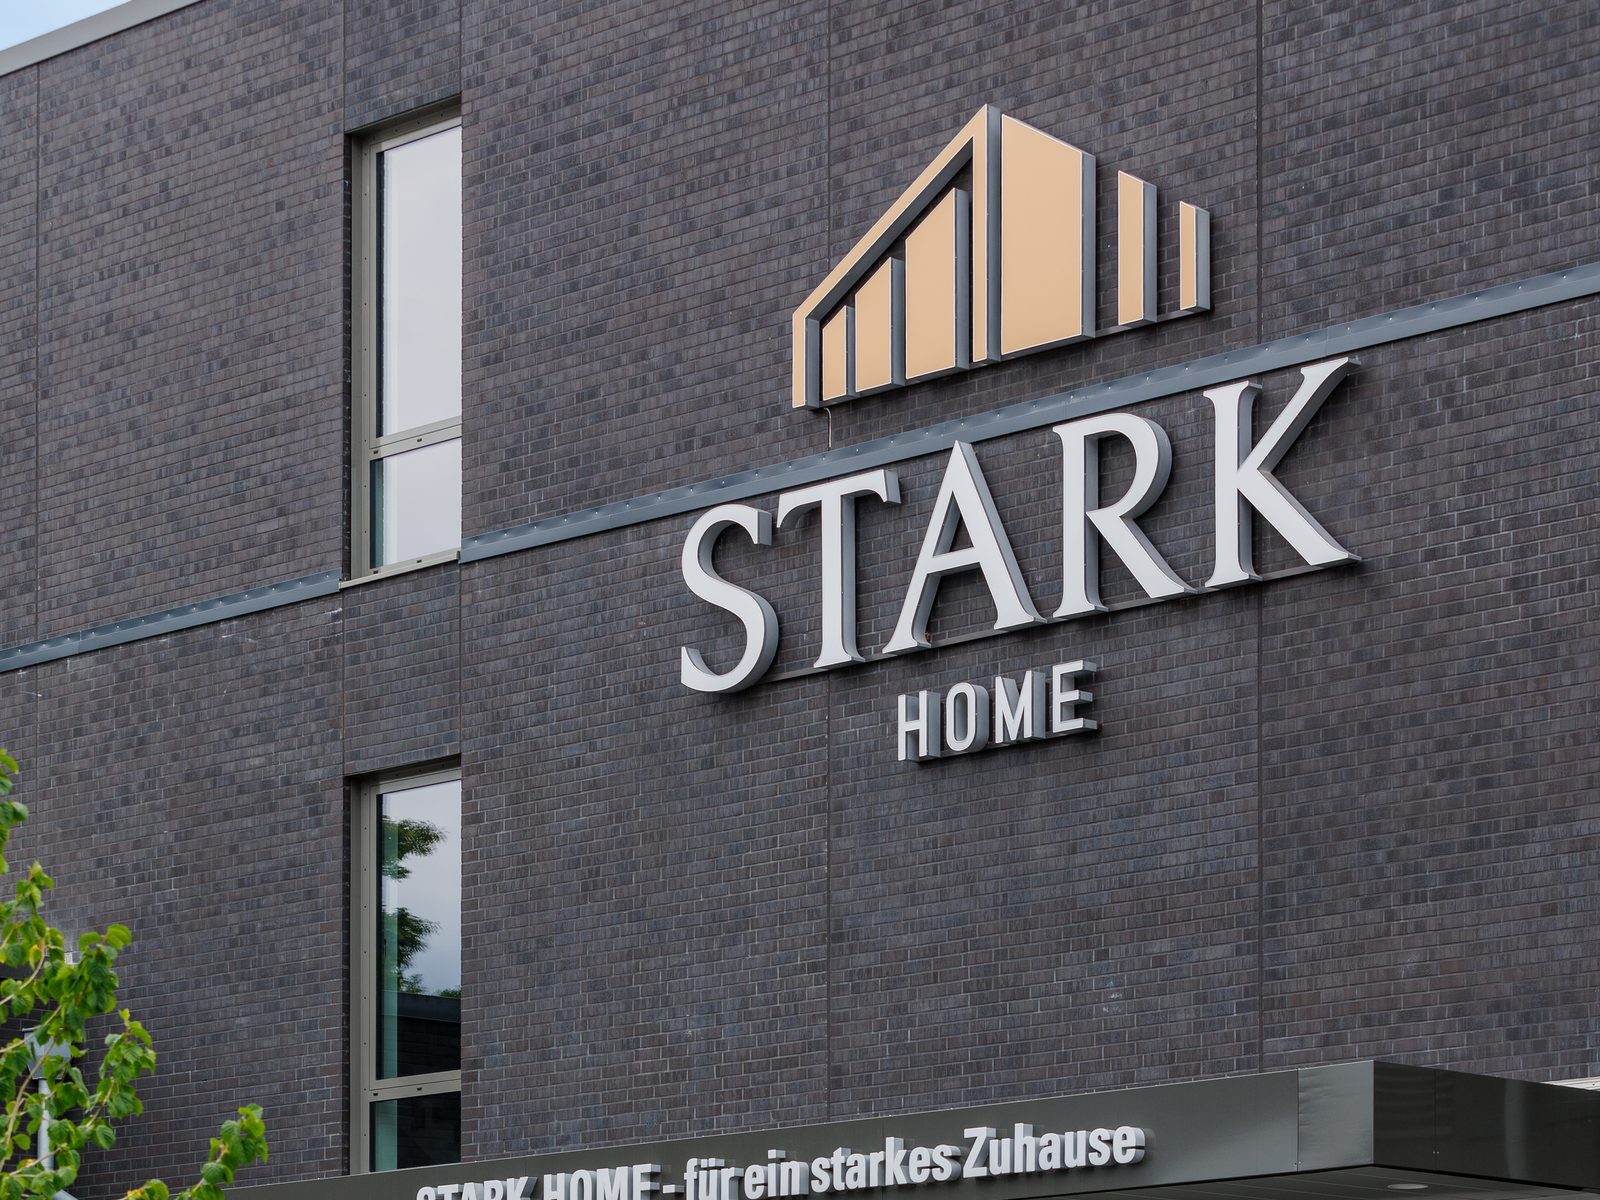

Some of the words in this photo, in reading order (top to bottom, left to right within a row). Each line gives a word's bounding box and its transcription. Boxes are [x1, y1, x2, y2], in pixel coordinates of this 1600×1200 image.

[681, 357, 1362, 693] STARK
[898, 660, 1098, 762] HOME
[744, 1149, 810, 1200] ein
[810, 1136, 962, 1193] starkes
[963, 1122, 1146, 1179] Zuhause
